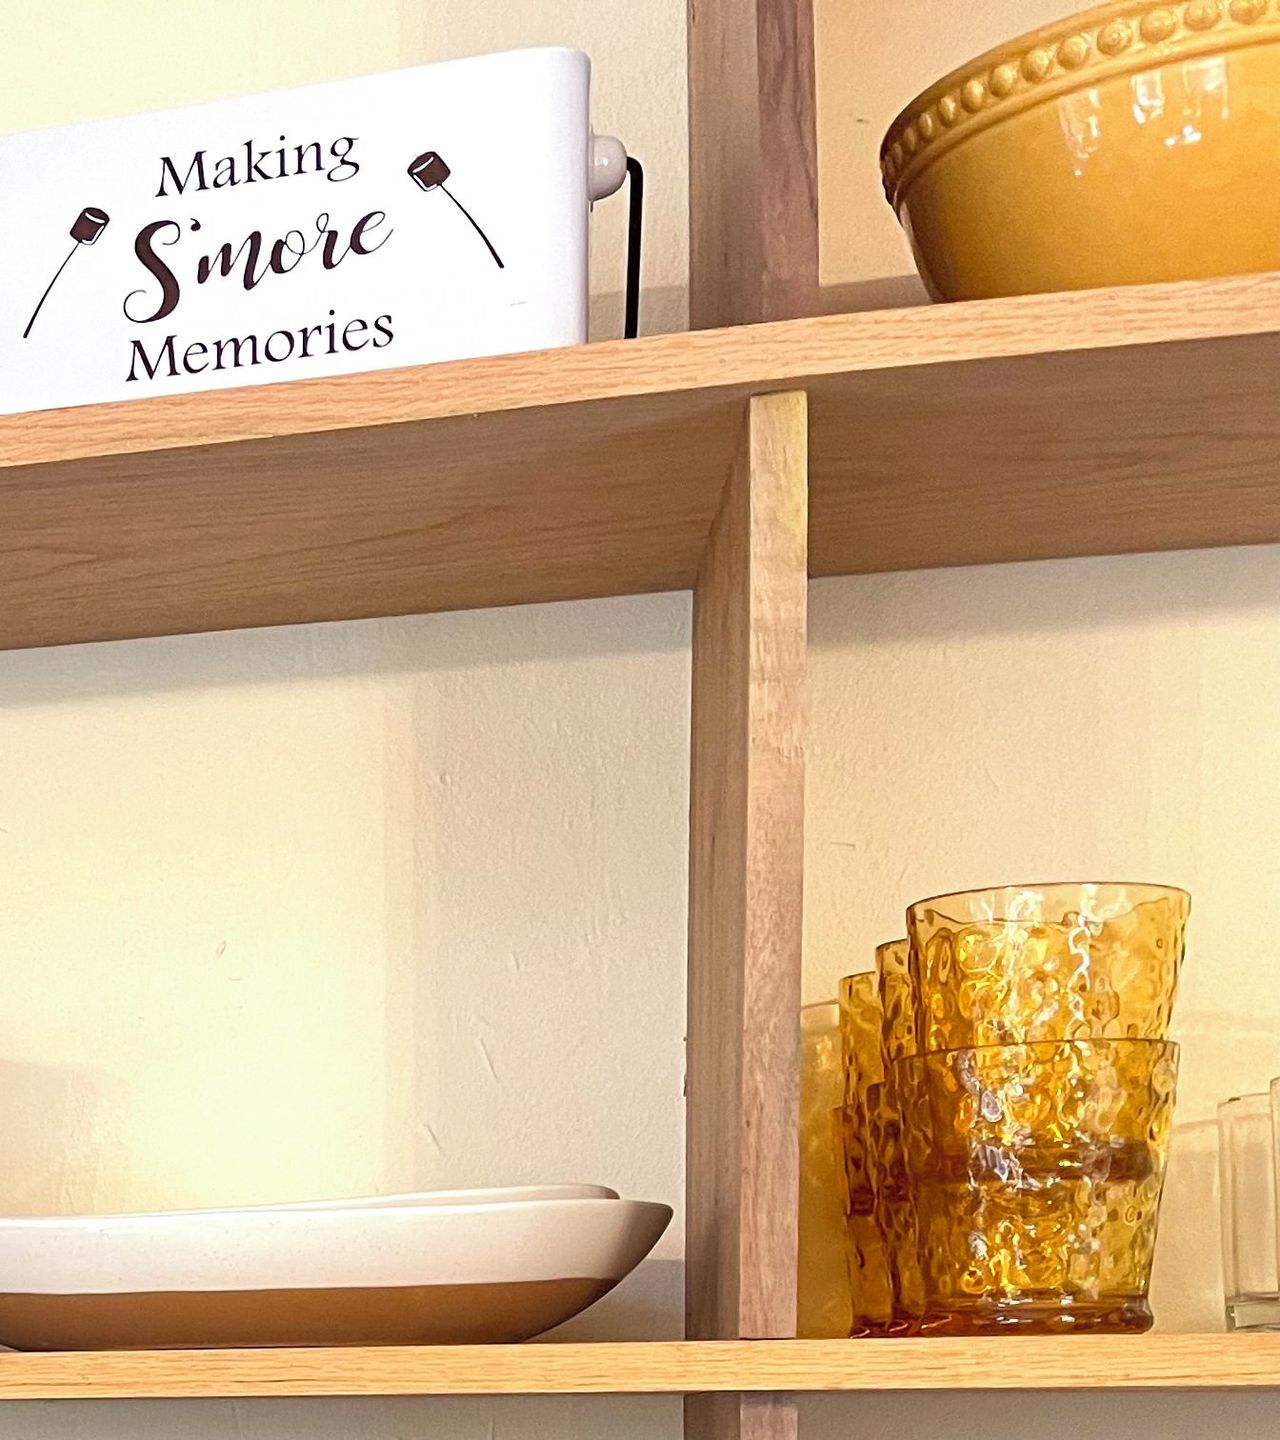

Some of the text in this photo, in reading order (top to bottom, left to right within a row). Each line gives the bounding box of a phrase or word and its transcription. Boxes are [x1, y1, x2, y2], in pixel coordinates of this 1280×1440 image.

[154, 134, 360, 198] Making
[122, 210, 395, 324] S'more
[125, 309, 394, 382] Memories
